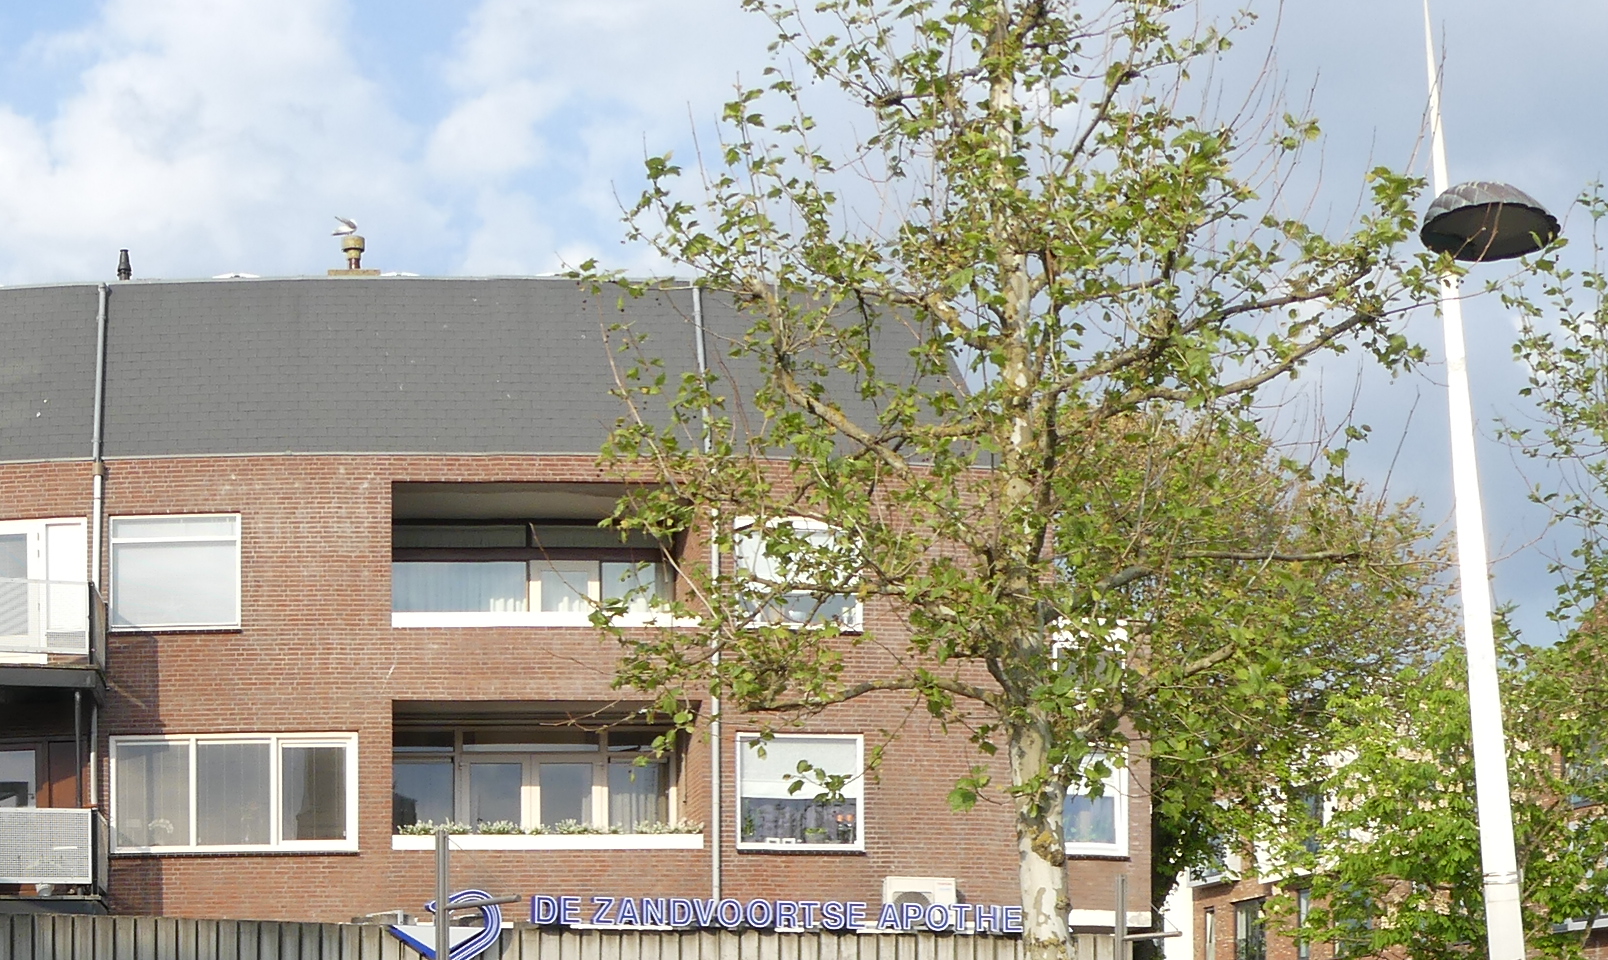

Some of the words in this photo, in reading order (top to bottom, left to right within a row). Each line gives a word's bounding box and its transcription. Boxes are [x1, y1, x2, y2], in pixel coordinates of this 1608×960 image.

[531, 895, 582, 926] DE
[591, 897, 867, 930] ZANDVOORTSE
[878, 902, 1024, 933] APOTHE
